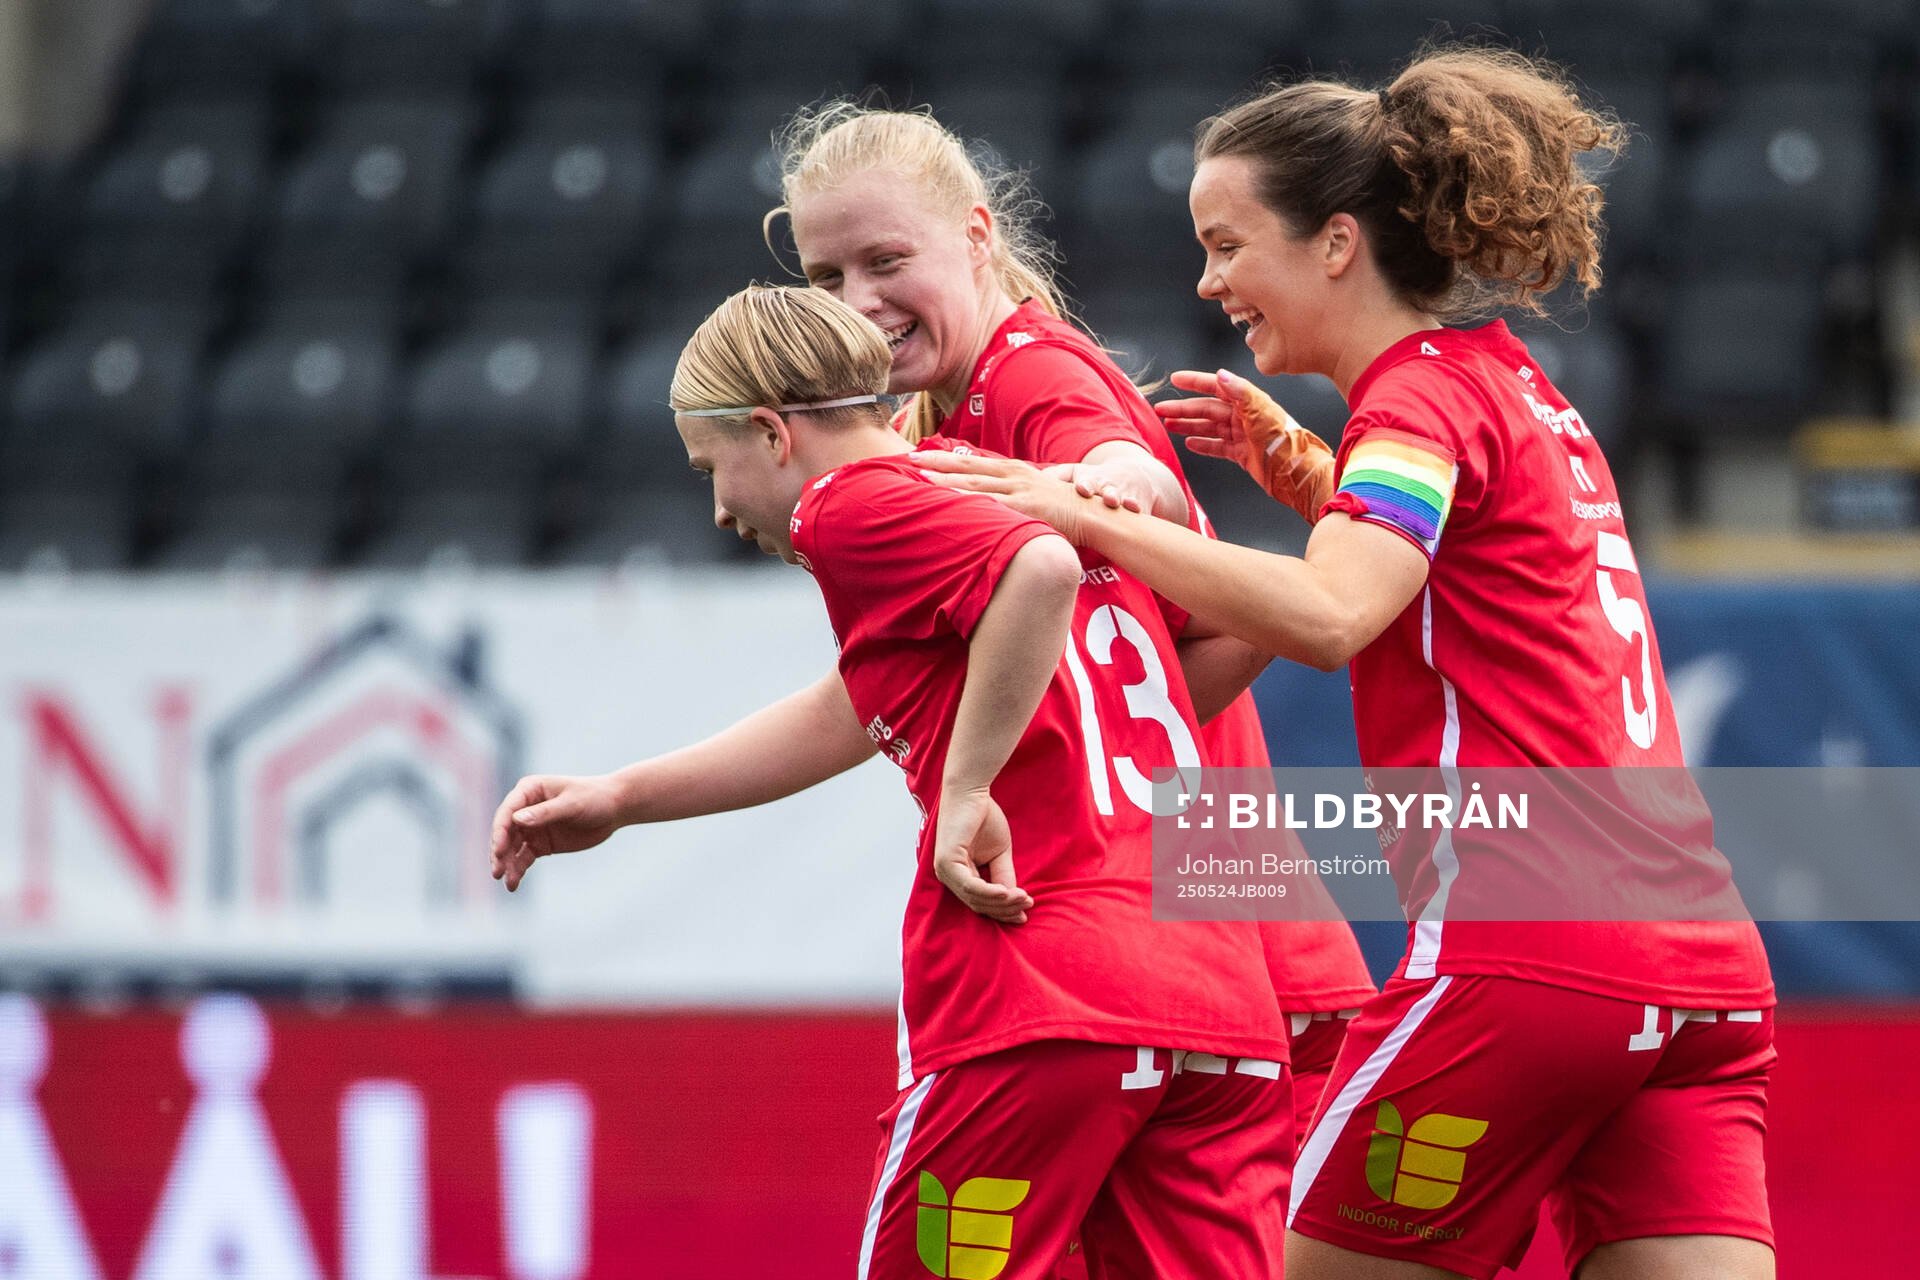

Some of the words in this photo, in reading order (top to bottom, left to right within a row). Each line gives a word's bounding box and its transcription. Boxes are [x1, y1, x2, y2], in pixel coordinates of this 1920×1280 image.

[1066, 604, 1202, 817] 13
[1596, 530, 1657, 749] 5
[8, 682, 195, 914] N
[1337, 1203, 1399, 1231] INDOOR
[1404, 1222, 1465, 1240] ENERGY
